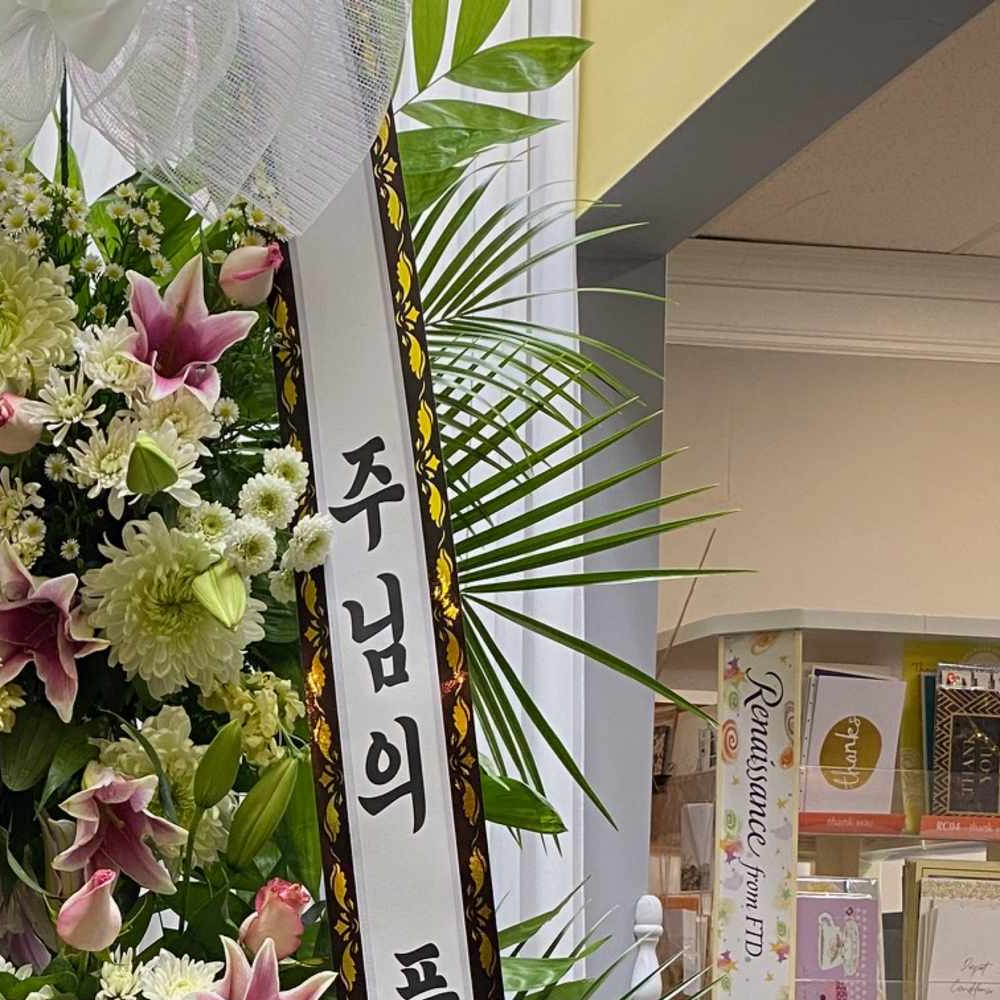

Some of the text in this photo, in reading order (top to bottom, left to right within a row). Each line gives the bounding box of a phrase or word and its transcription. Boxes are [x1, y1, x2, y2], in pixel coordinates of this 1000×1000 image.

[328, 435, 427, 834] 주님의
[739, 667, 784, 957] Renaissance from FTD
